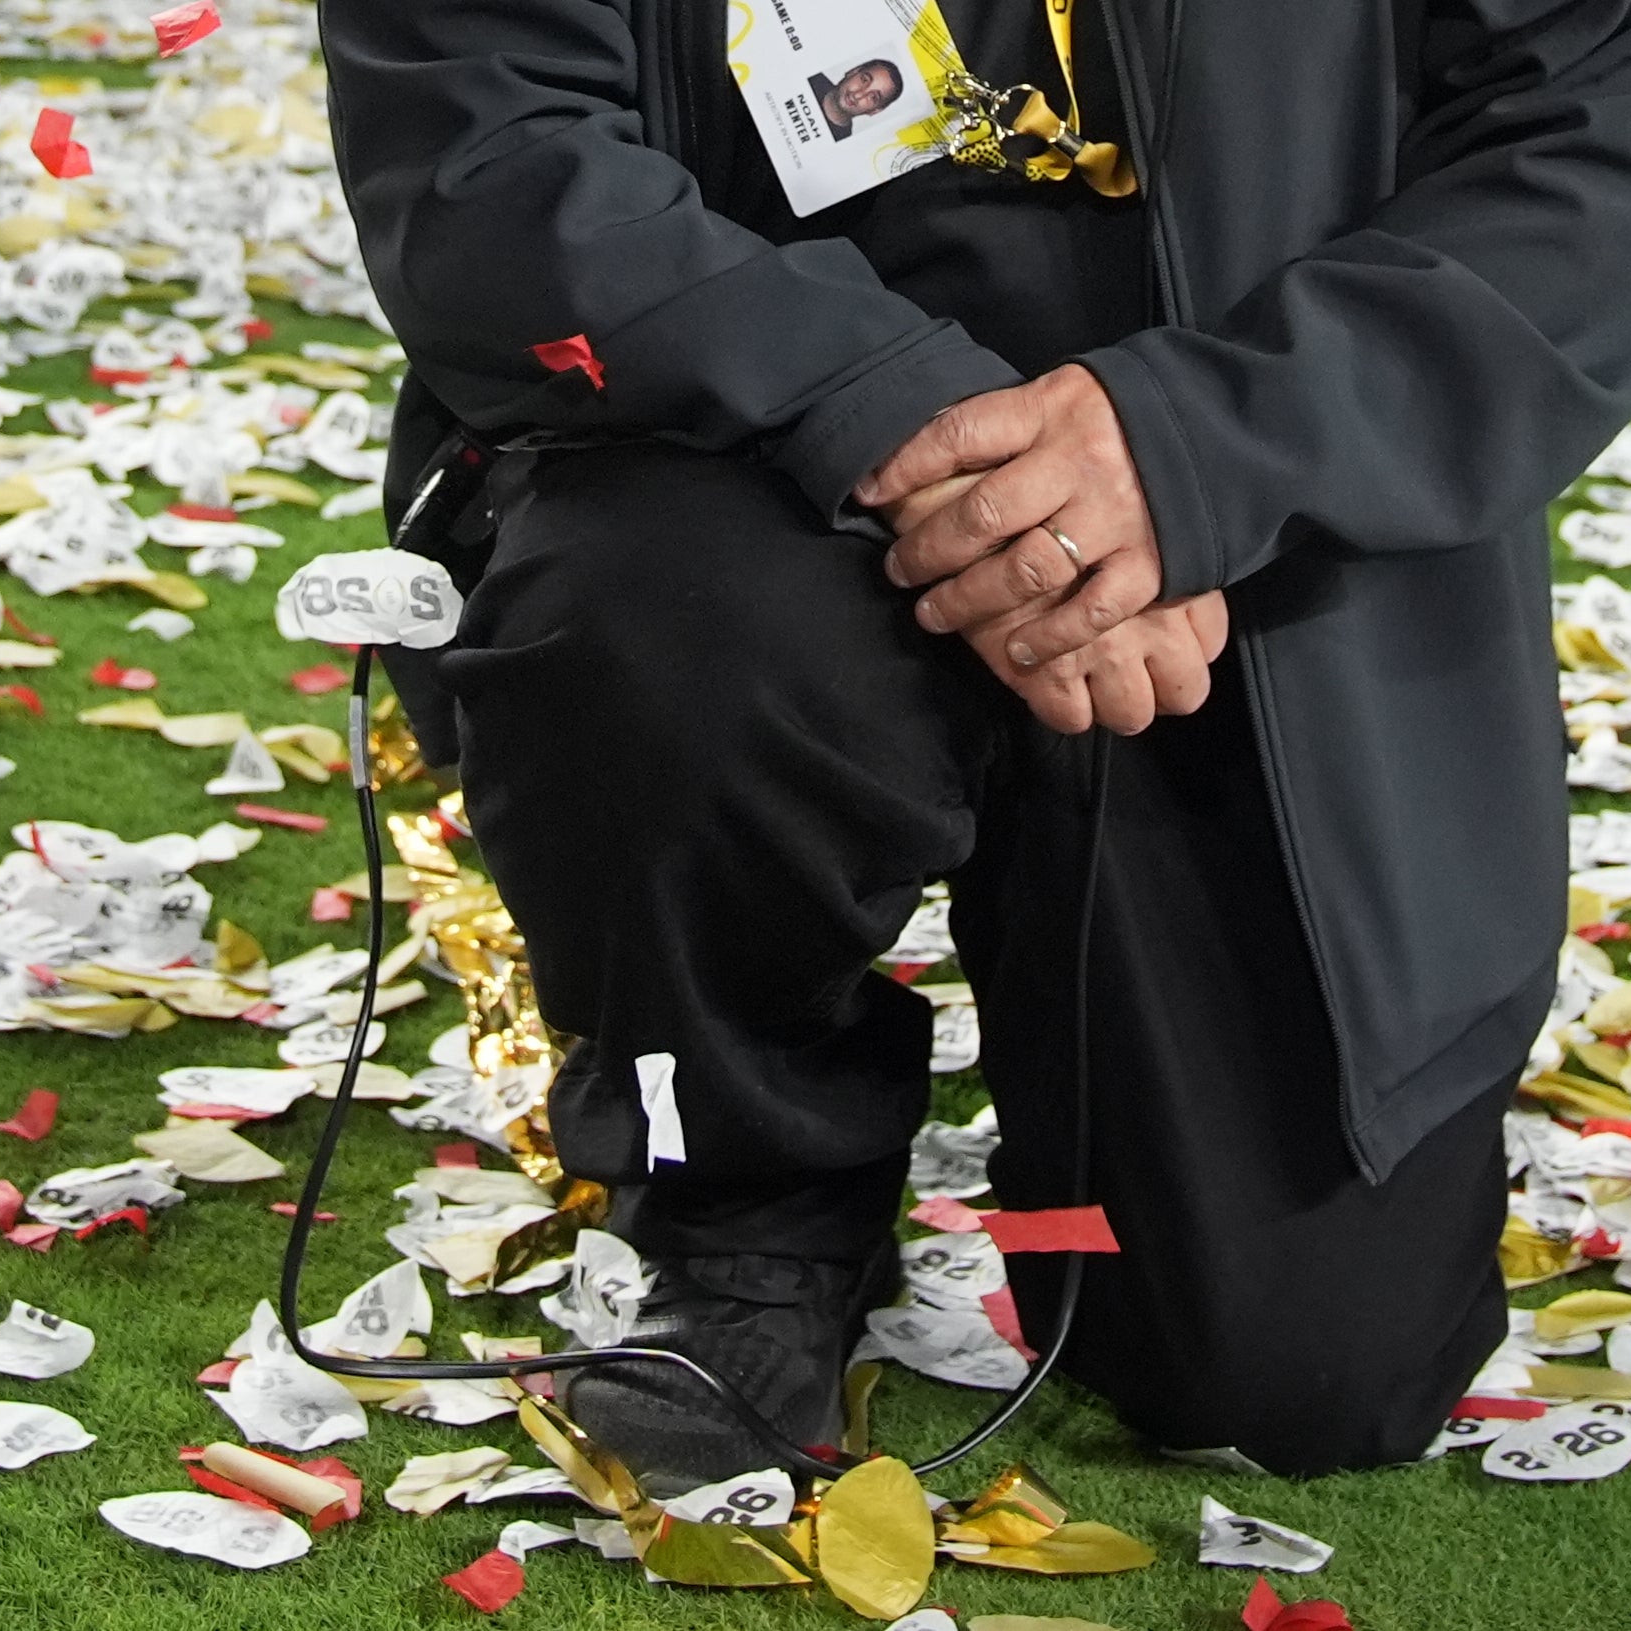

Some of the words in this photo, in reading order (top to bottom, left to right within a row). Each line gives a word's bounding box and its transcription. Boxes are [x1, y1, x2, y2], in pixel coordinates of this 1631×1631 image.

[783, 25, 803, 52] 0:00
[783, 98, 811, 144] WINTER
[796, 93, 822, 139] NOAH
